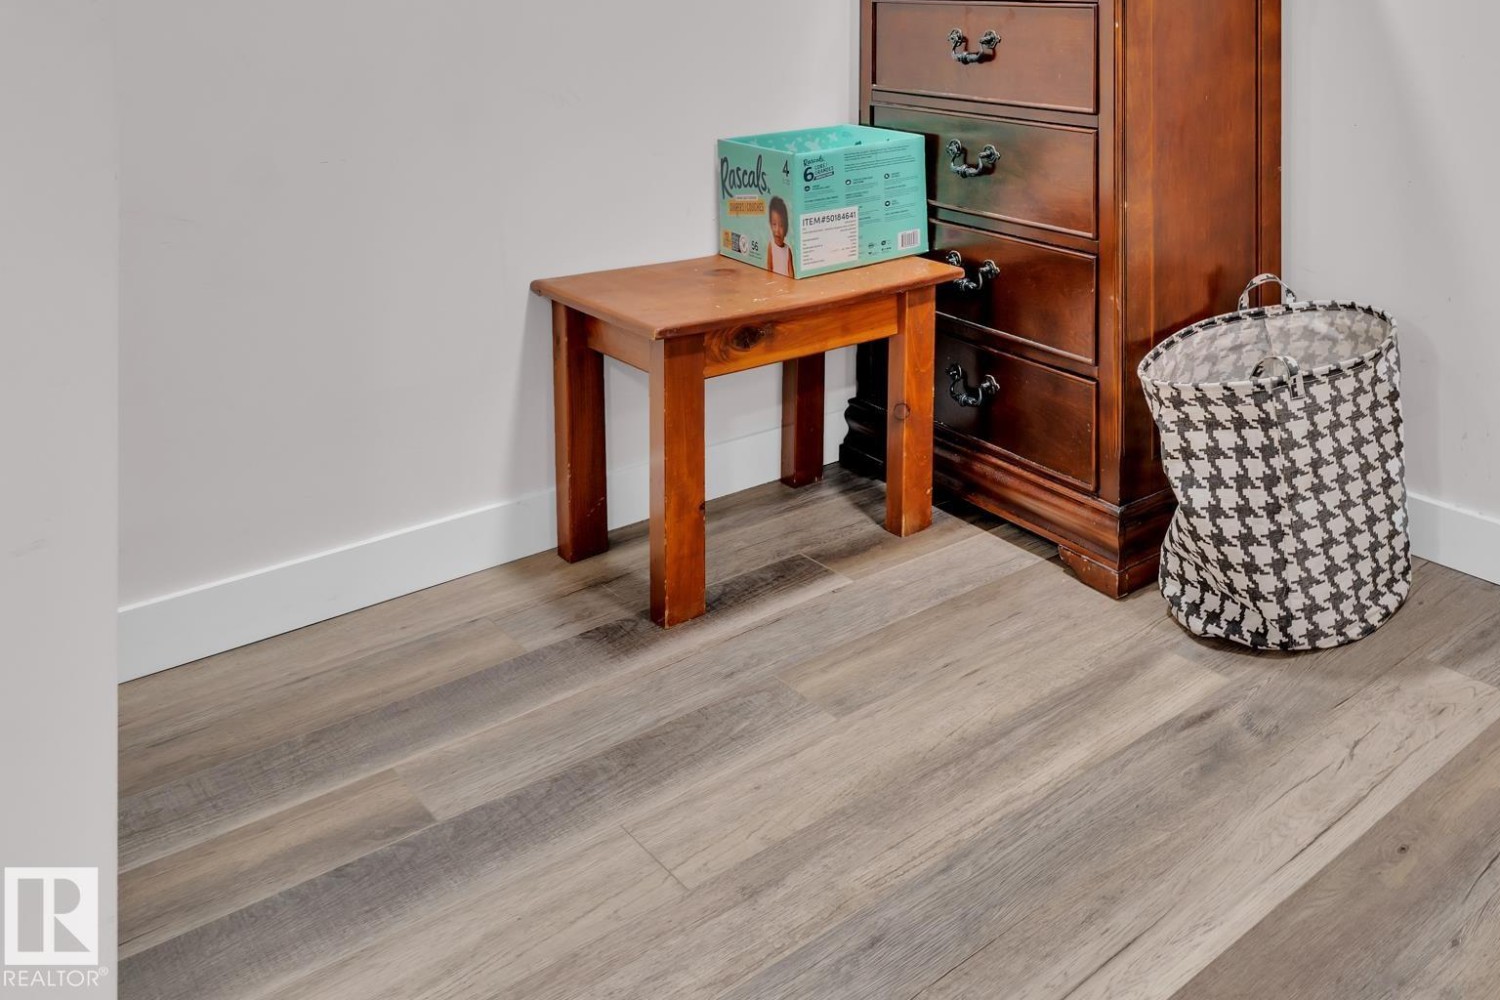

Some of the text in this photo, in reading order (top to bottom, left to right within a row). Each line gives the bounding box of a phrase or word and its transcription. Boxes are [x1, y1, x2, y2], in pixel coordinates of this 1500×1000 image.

[782, 160, 790, 177] 4
[804, 166, 814, 182] 6
[751, 240, 759, 251] 56
